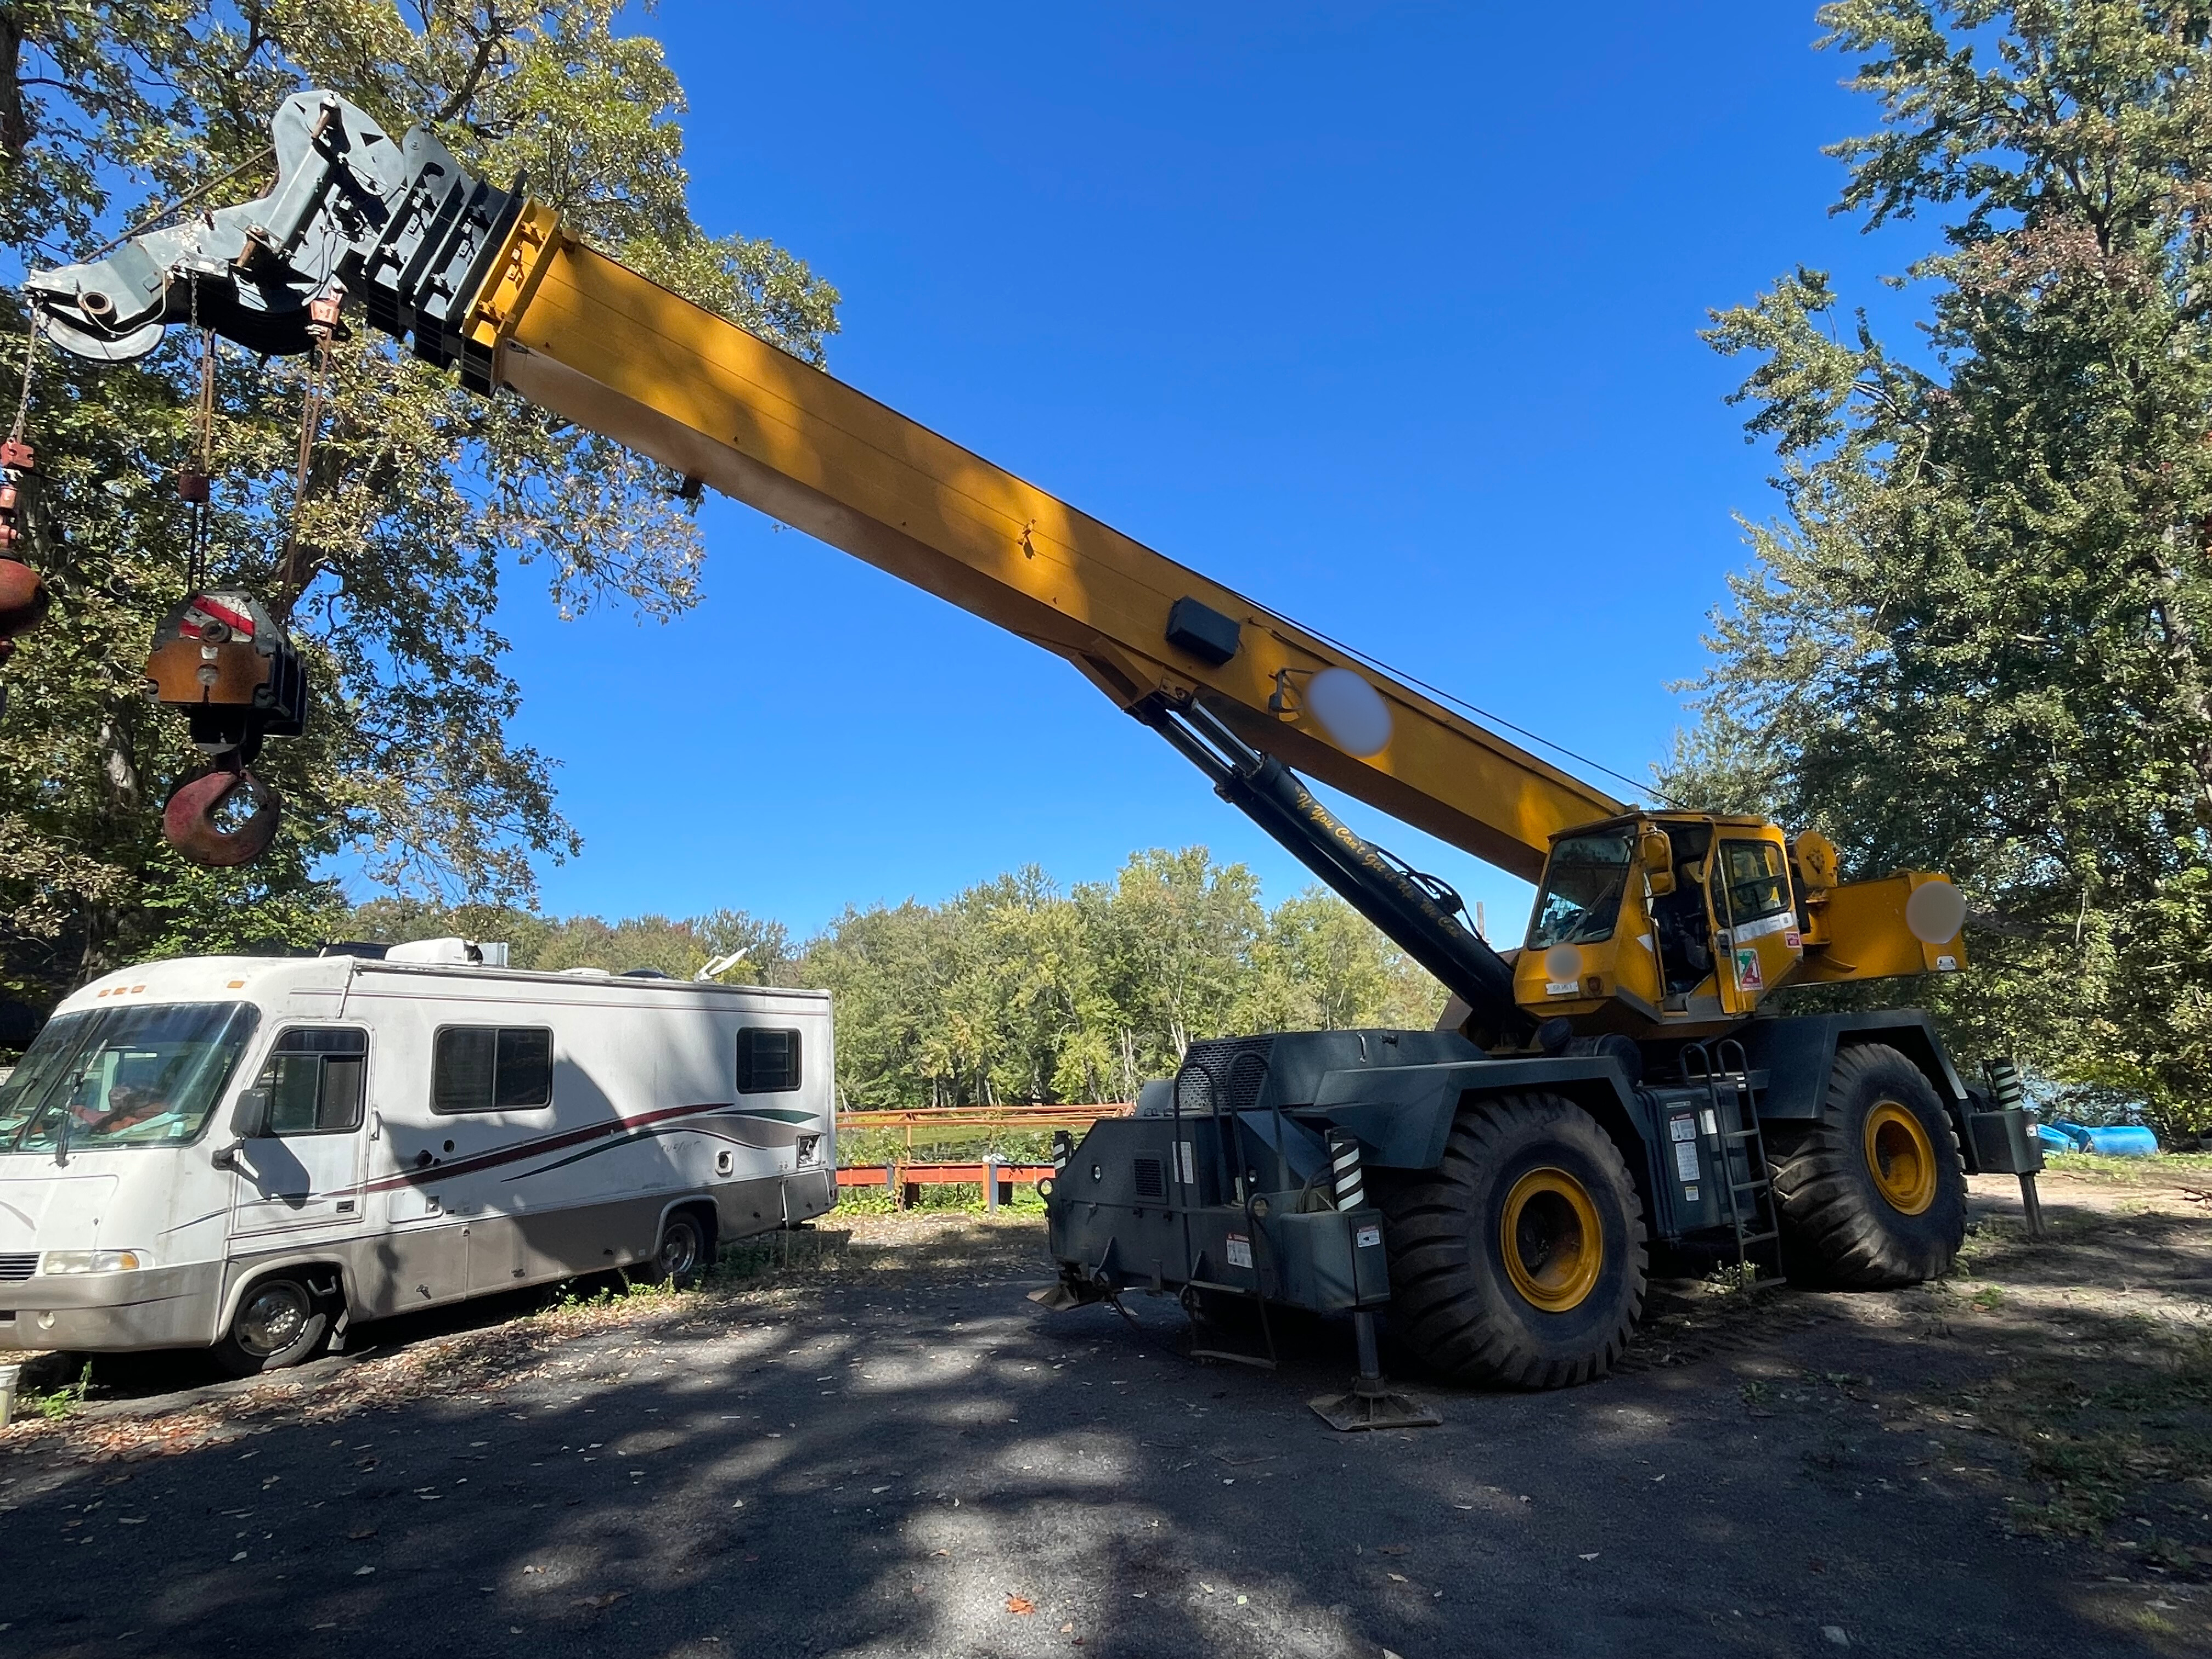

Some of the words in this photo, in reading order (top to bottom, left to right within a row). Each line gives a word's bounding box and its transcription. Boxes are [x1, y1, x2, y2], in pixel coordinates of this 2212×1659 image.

[1310, 805, 1334, 829] You
[1335, 827, 1365, 854] Can't
[1362, 854, 1386, 872] Get
